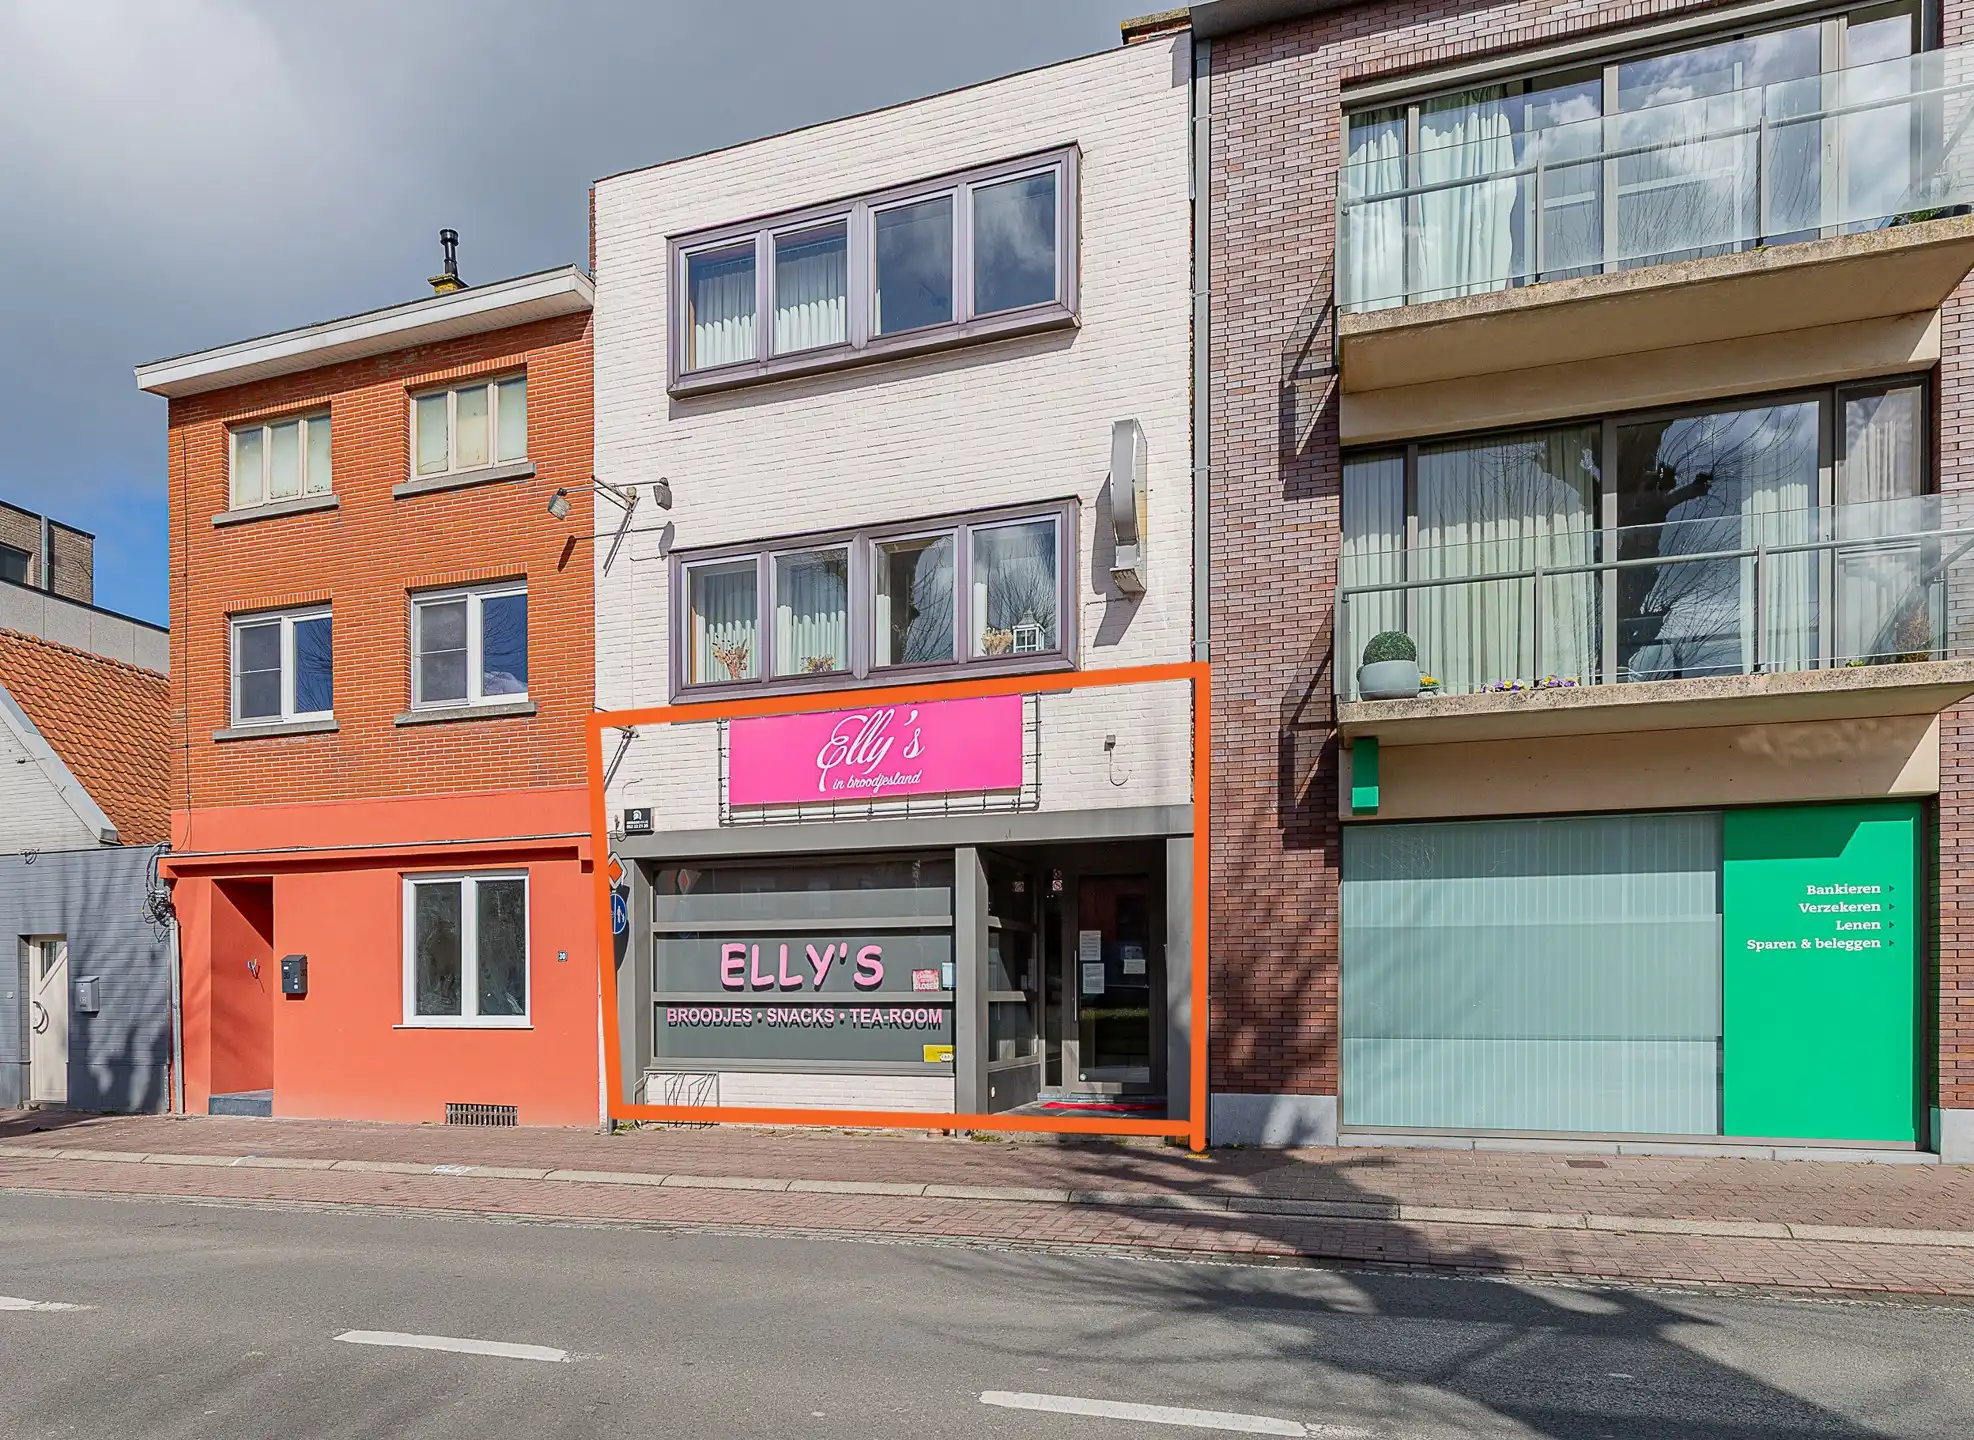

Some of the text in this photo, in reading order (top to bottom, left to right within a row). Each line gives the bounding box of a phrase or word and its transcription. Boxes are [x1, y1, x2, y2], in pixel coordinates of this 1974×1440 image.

[816, 708, 925, 792] Elly's
[832, 769, 923, 793] in broodjesland
[1806, 883, 1881, 895] Bankieren
[1798, 901, 1881, 913] Verzekeren
[1836, 919, 1881, 930] Lenen
[1746, 937, 1881, 952] Sparen & beleggen
[720, 942, 884, 987] ELLY'S
[666, 1008, 943, 1024] BROODJES SNACKS TEA-ROOM
